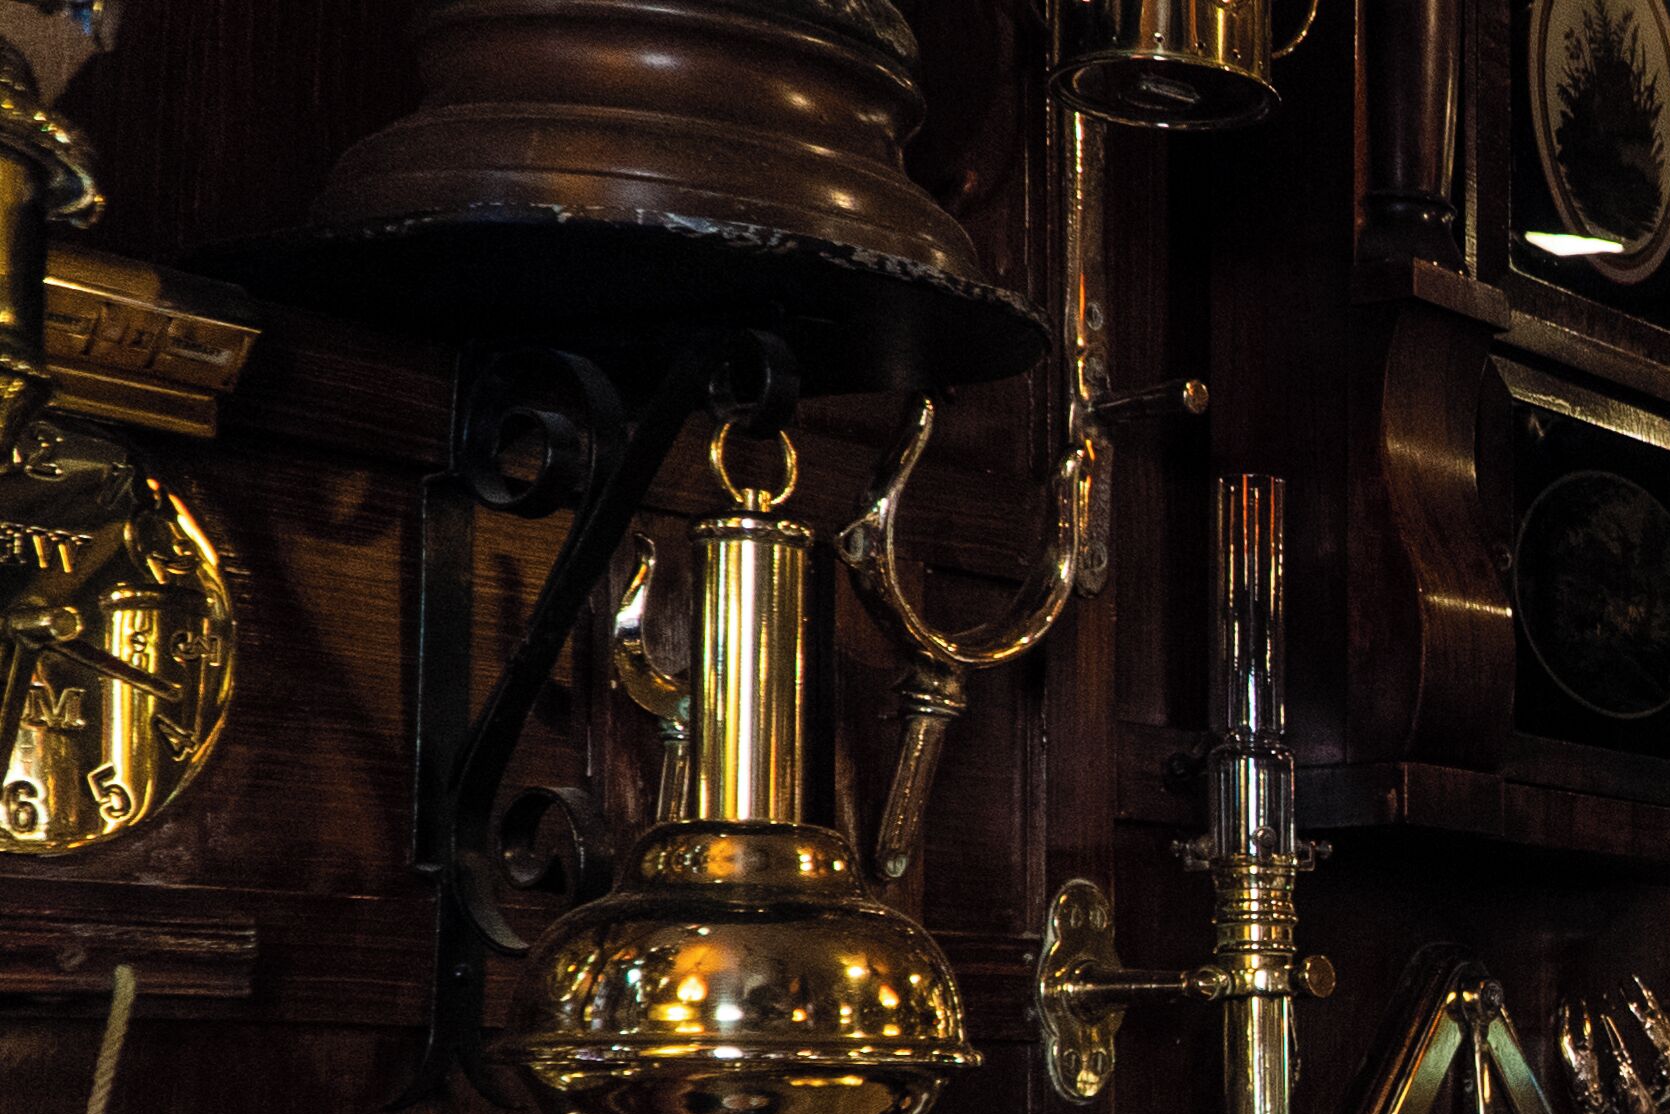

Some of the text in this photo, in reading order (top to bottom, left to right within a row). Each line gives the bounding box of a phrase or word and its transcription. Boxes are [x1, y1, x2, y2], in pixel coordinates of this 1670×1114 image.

[155, 713, 198, 762] 4
[6, 780, 40, 834] 6
[87, 761, 136, 822] 5
